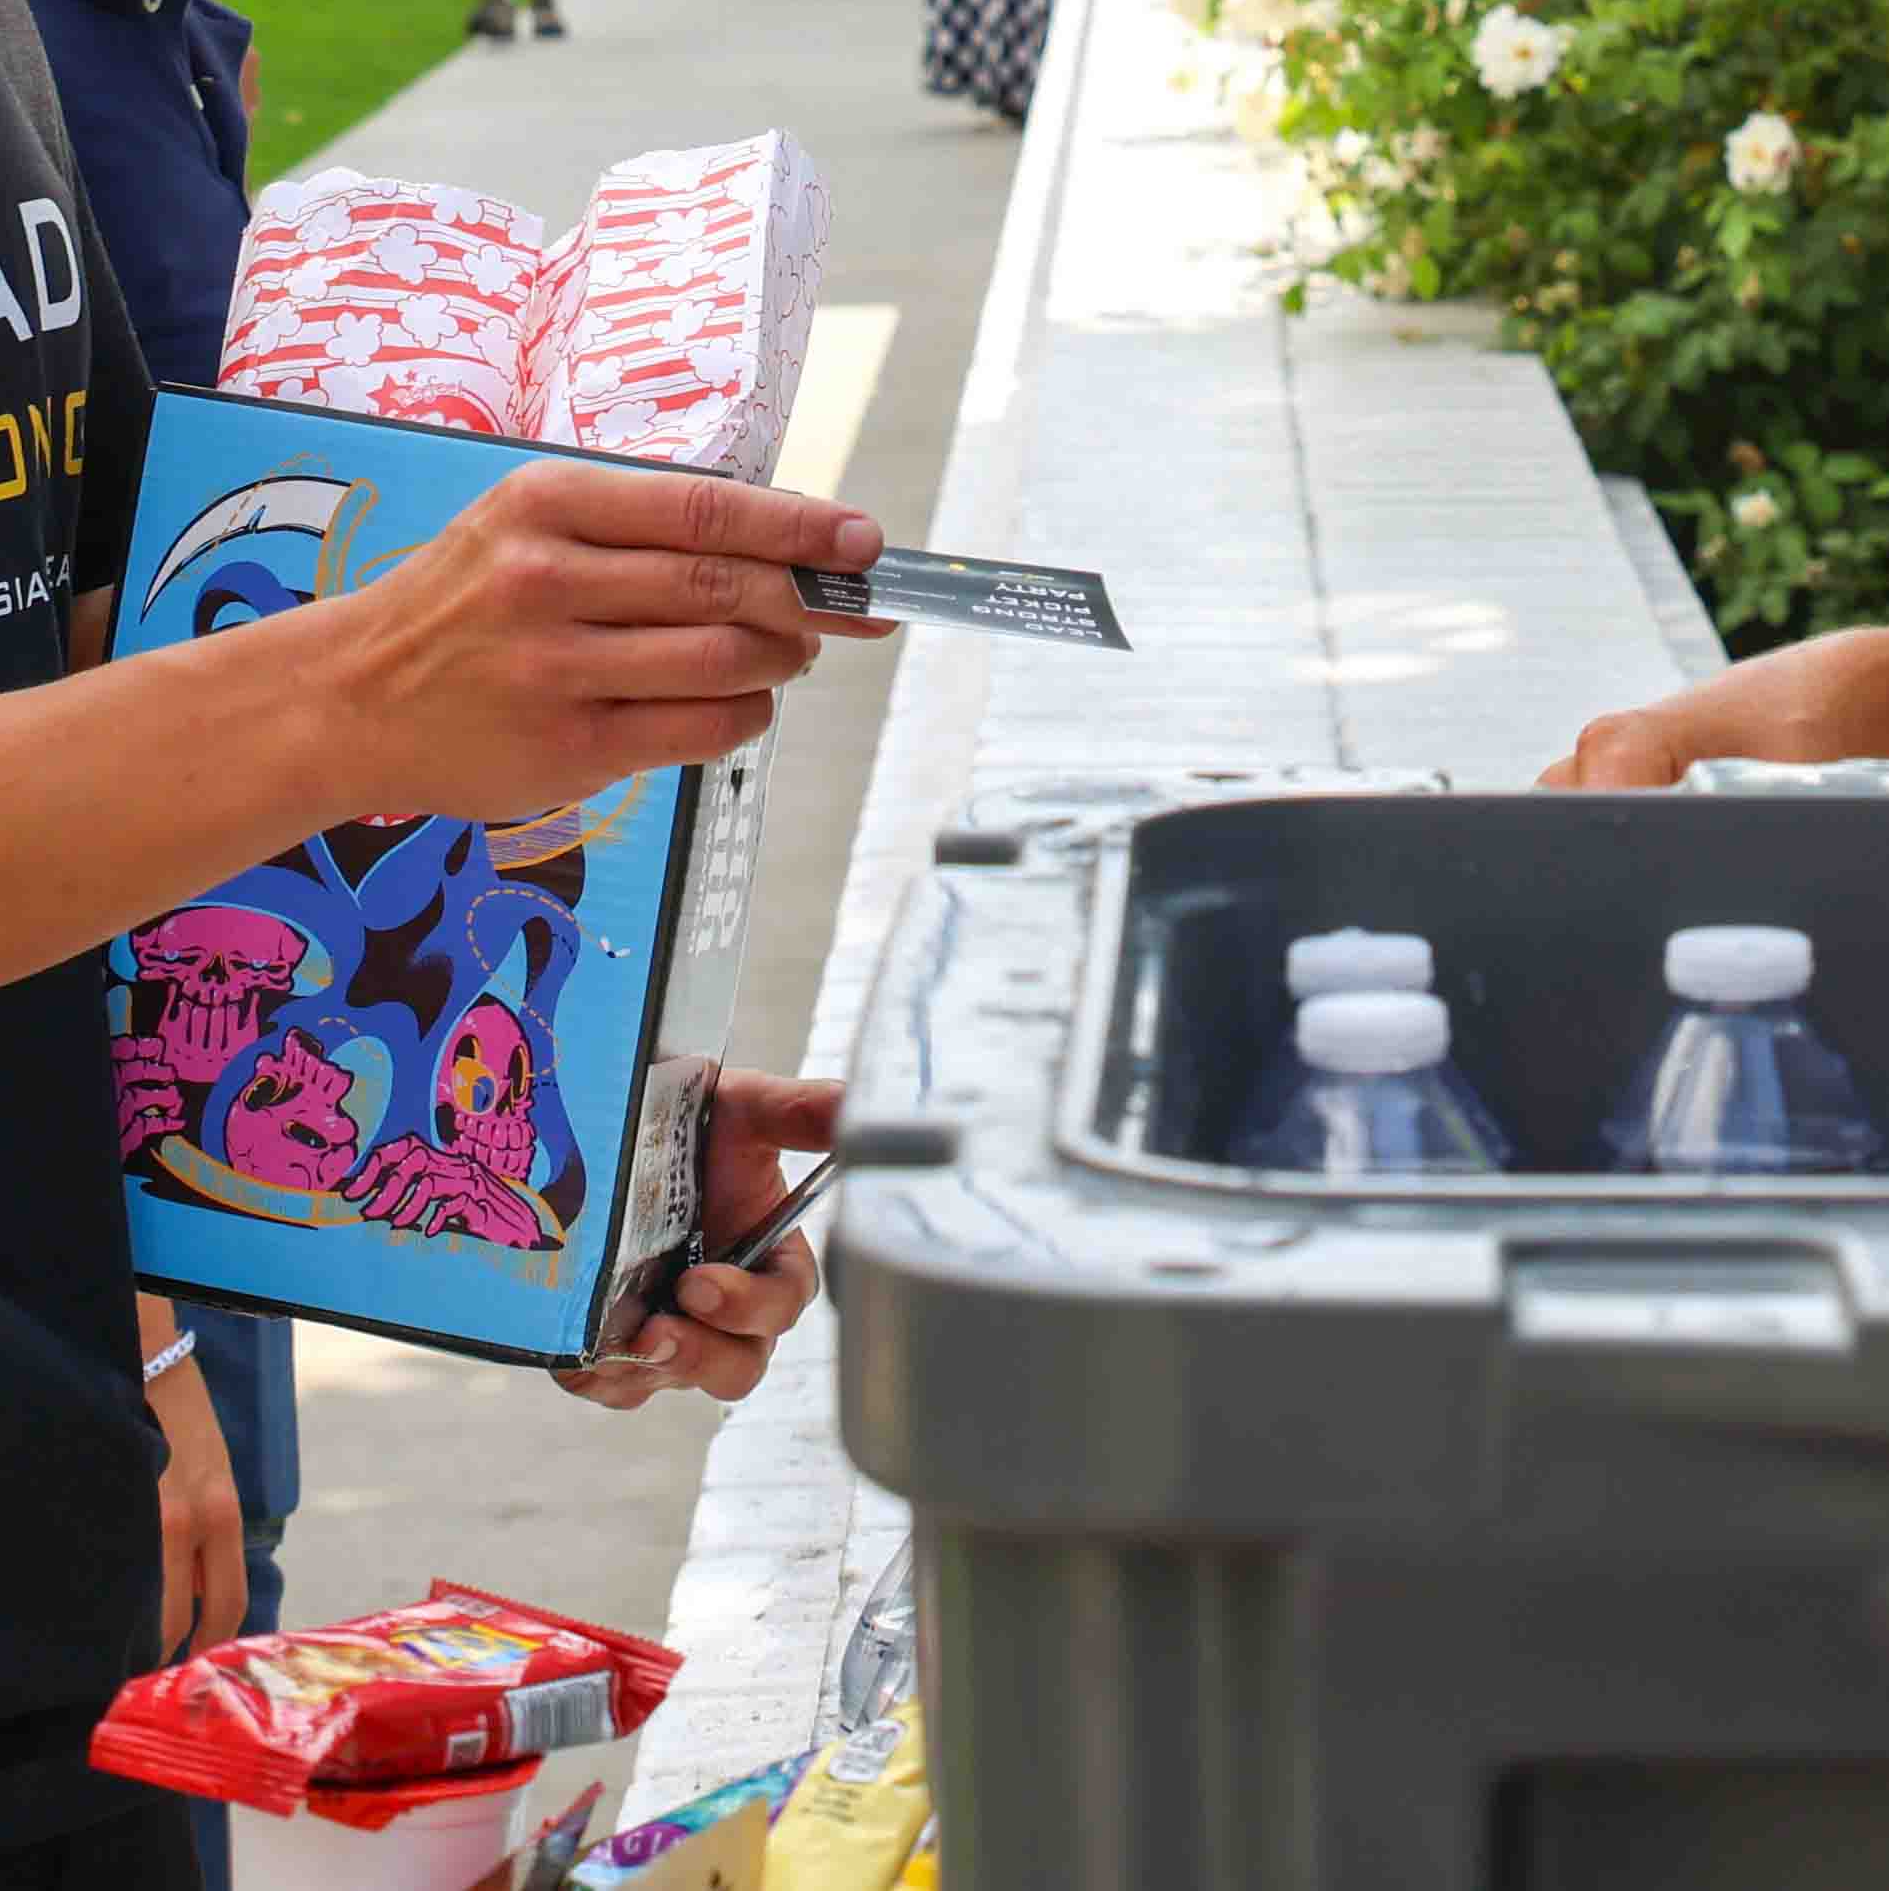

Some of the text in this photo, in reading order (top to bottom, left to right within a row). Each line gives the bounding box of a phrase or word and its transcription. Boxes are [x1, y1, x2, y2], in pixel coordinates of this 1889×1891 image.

[995, 582, 1087, 601] PARTY
[985, 593, 1092, 616] PICKET
[970, 604, 1098, 628] STRONG
[1024, 621, 1103, 639] LEAD
